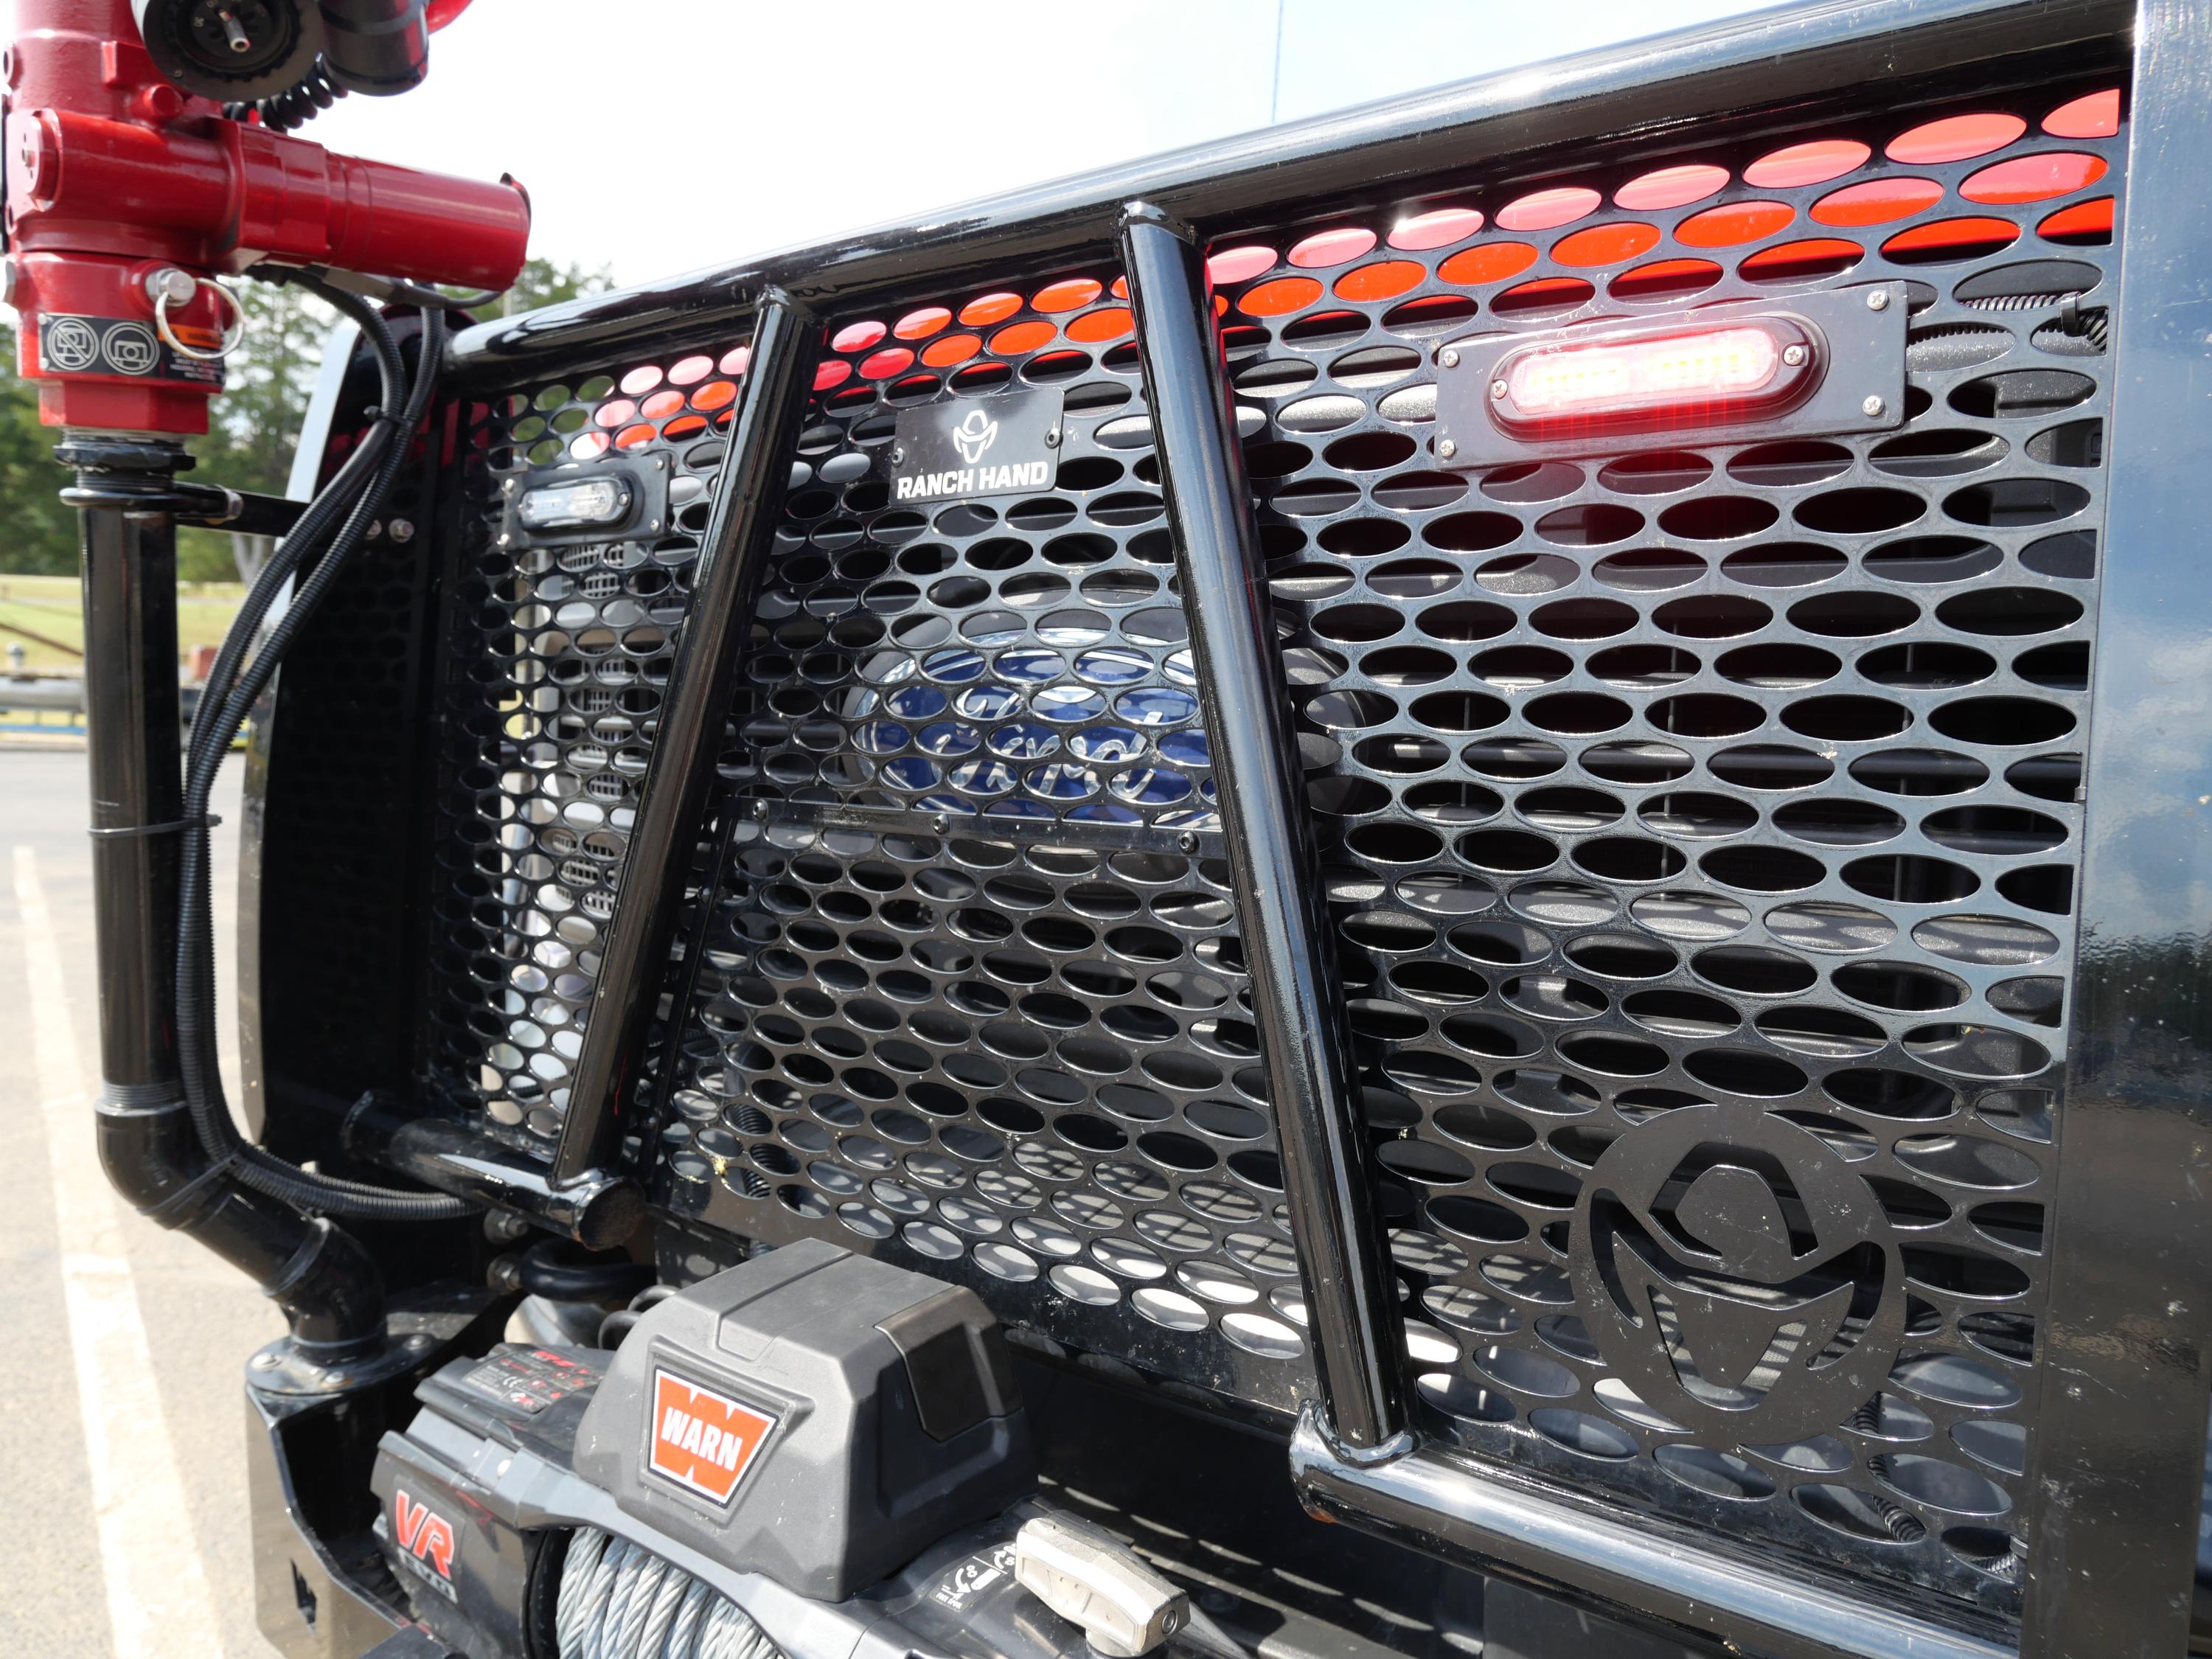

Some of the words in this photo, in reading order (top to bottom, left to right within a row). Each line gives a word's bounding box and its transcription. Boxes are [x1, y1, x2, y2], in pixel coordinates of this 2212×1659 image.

[897, 468, 973, 499] RANCH
[979, 461, 1048, 490] HAND
[661, 1405, 743, 1472] WARN
[396, 1489, 455, 1582] VR
